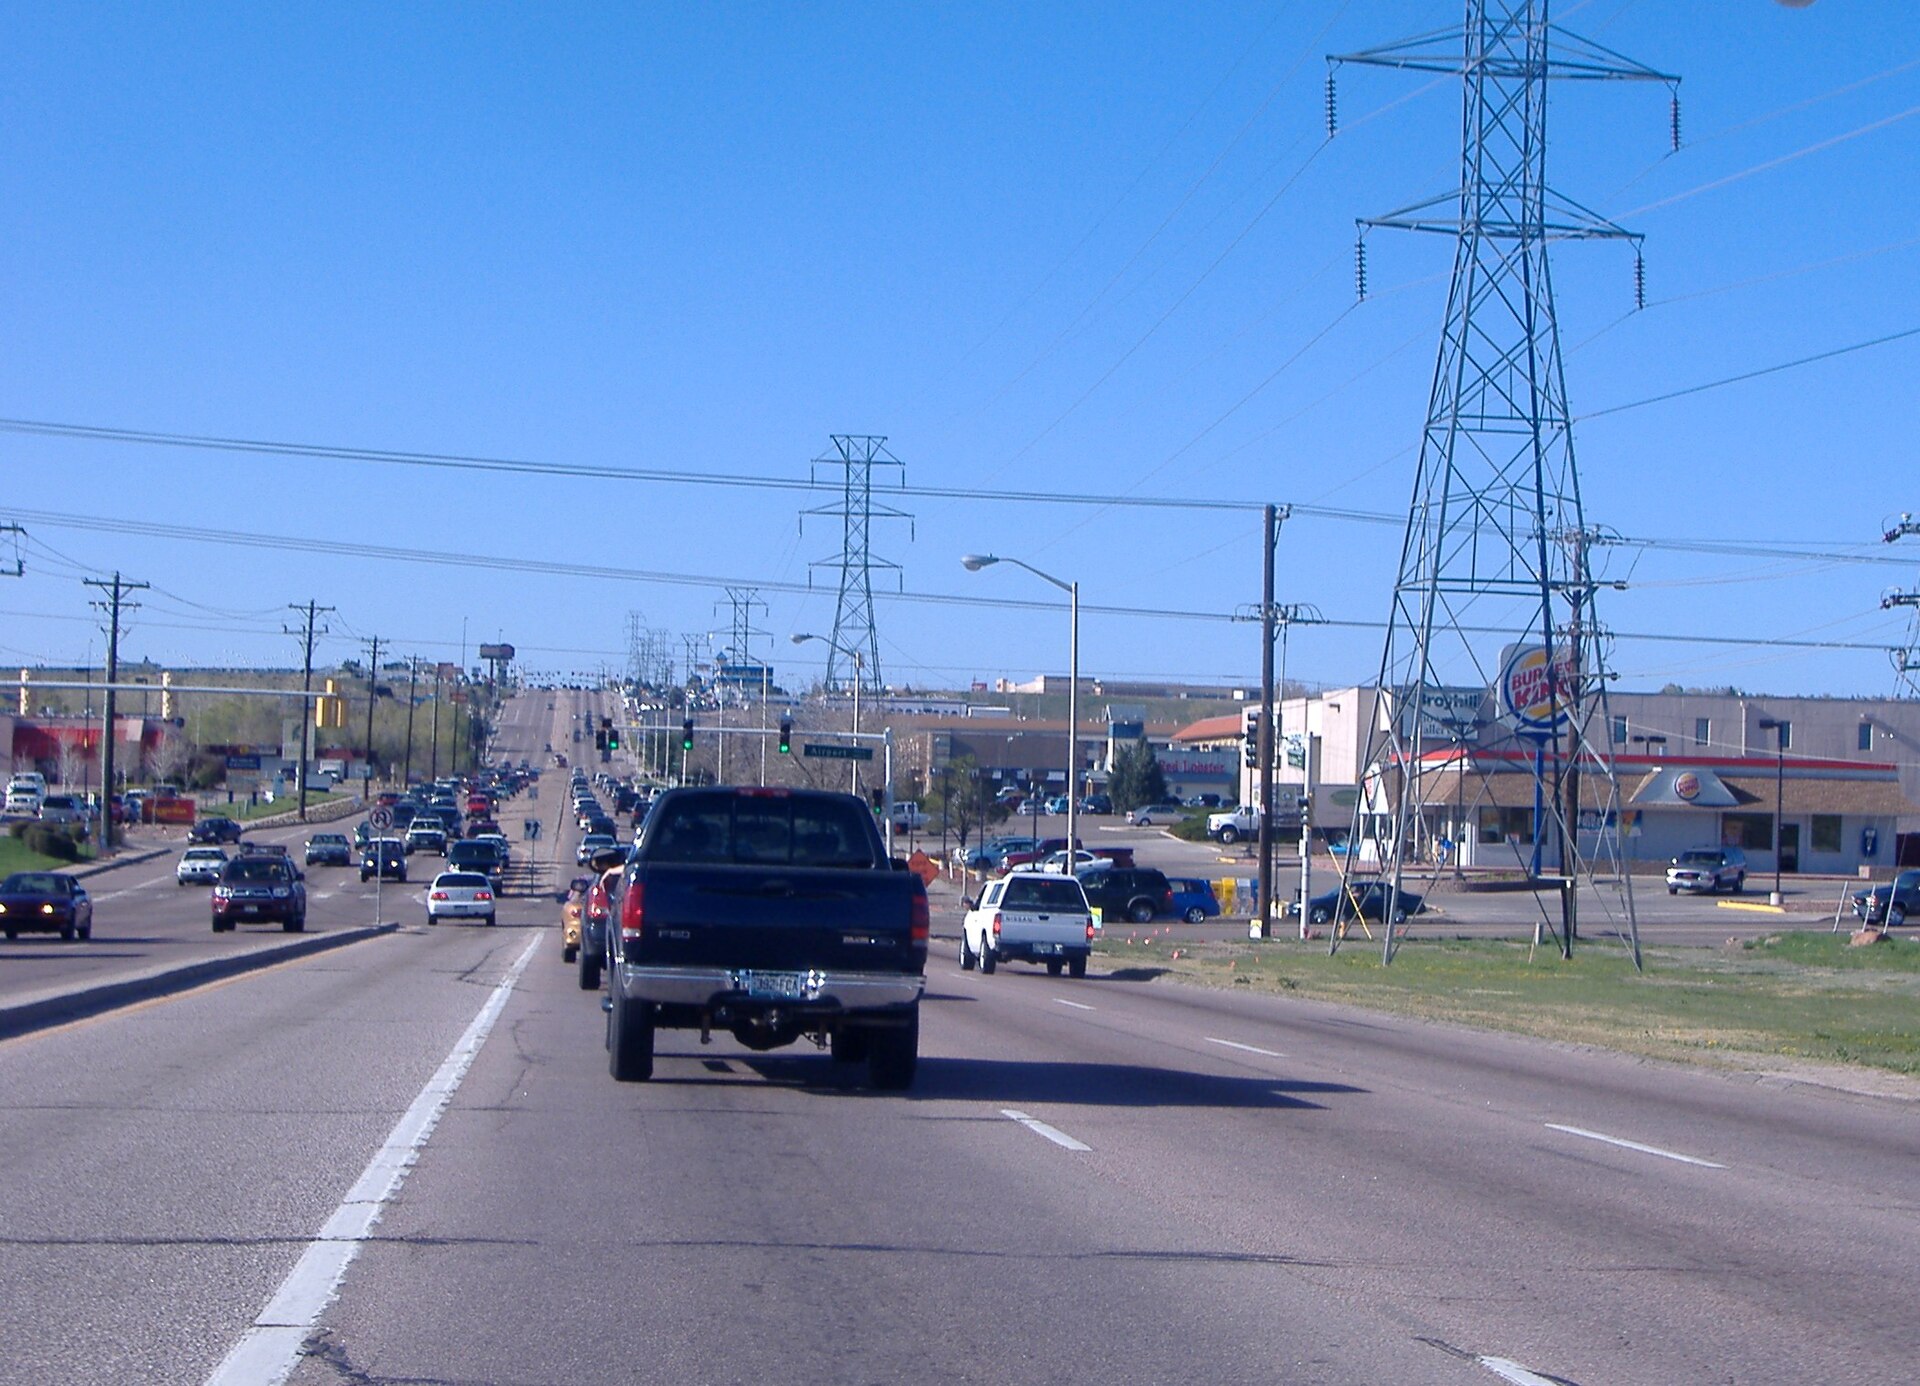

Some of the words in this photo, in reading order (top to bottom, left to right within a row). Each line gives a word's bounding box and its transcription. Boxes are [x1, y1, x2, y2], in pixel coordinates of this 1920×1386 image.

[1512, 661, 1571, 691] BURER
[1184, 760, 1225, 774] Lobster
[1005, 915, 1033, 923] NISSAN
